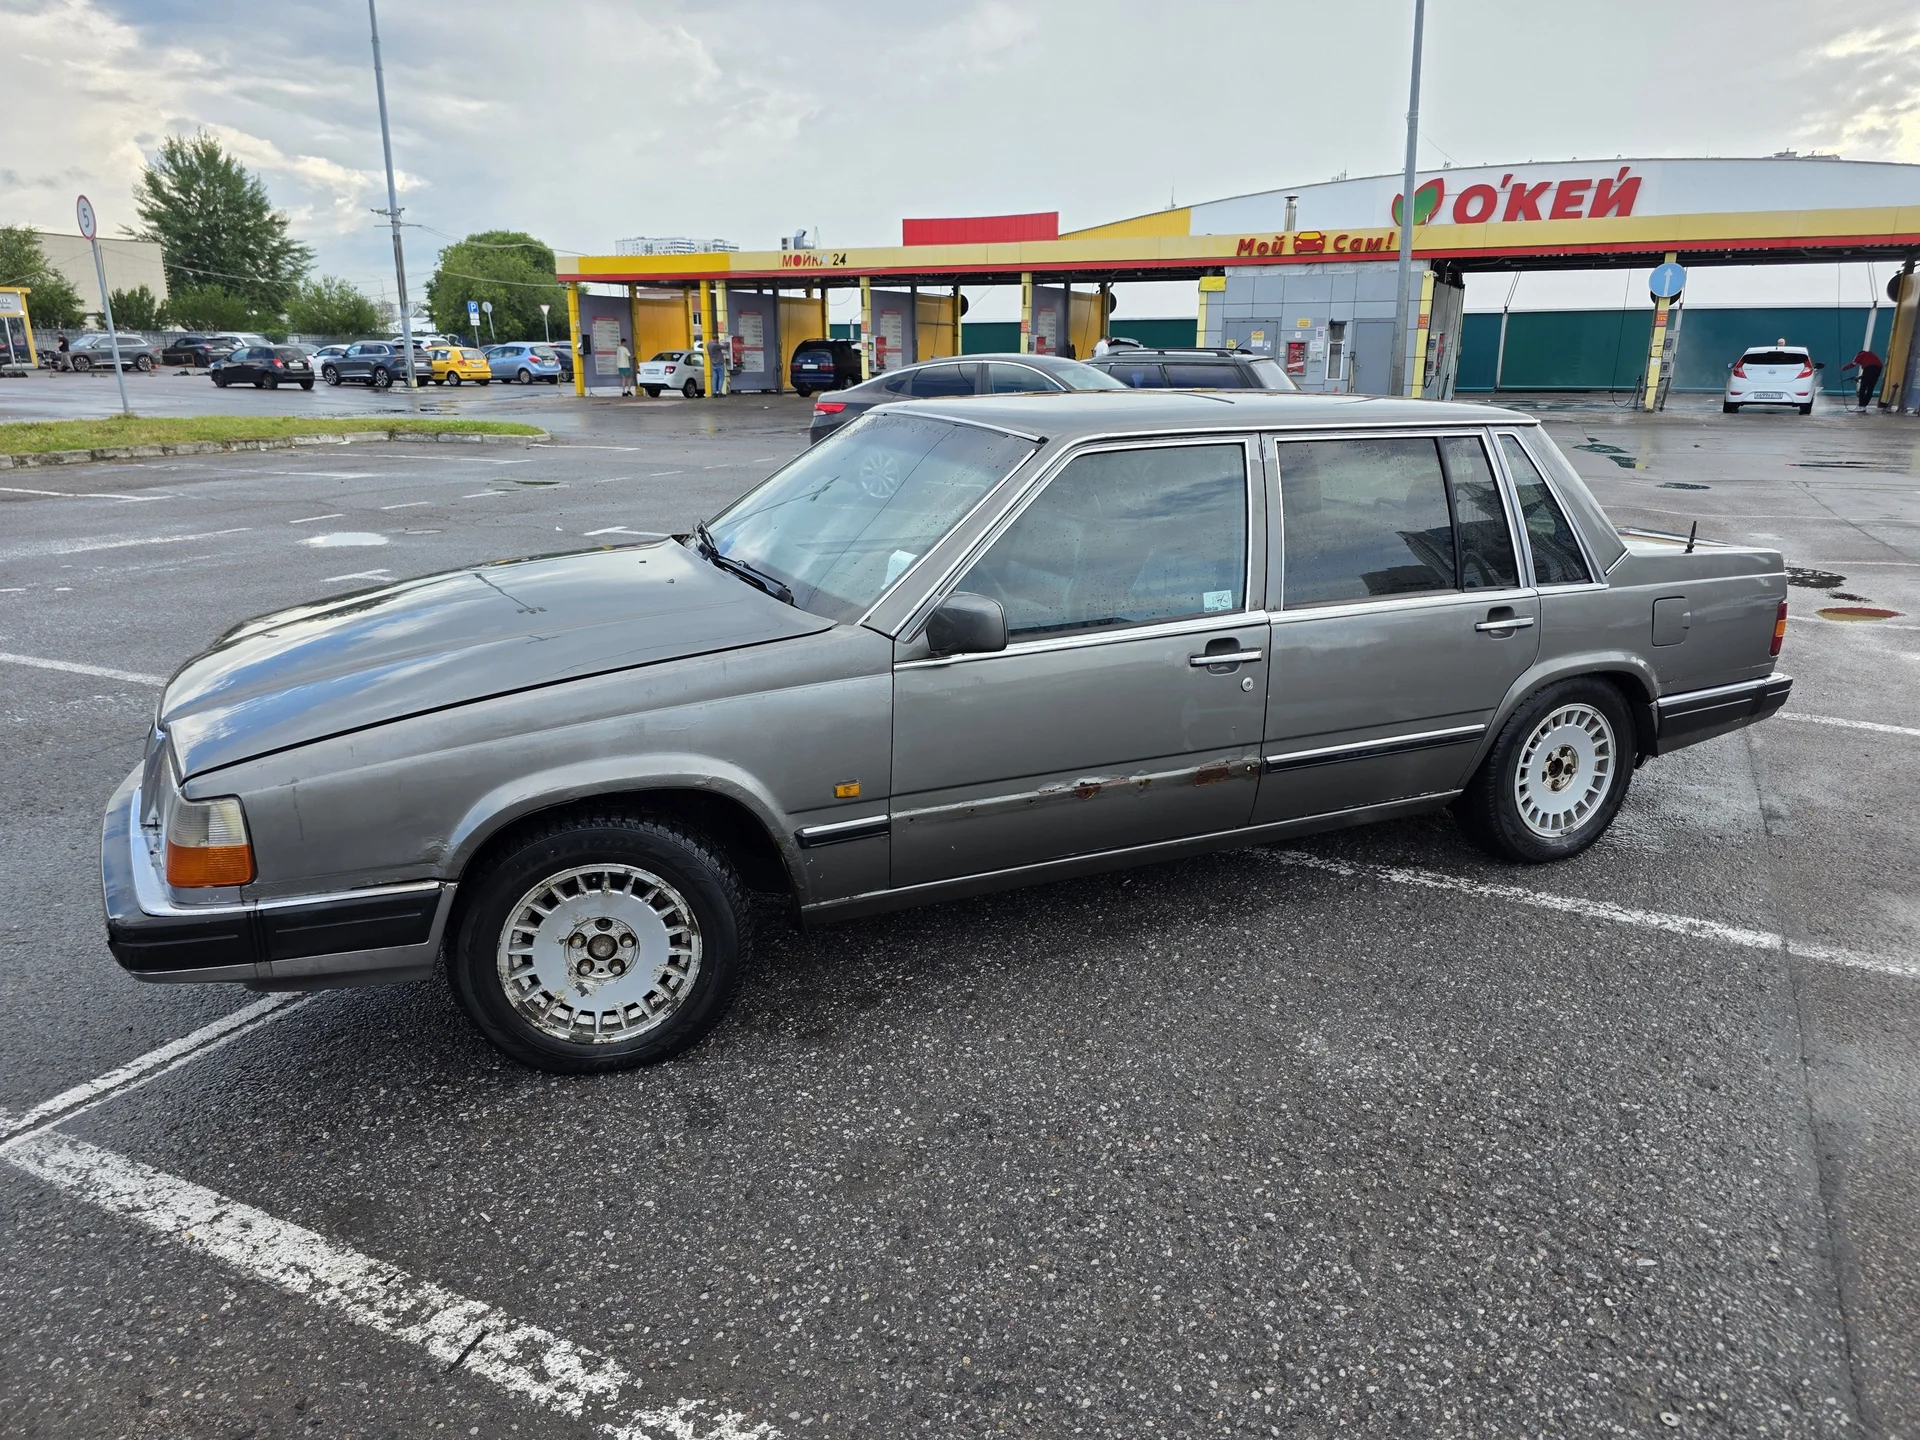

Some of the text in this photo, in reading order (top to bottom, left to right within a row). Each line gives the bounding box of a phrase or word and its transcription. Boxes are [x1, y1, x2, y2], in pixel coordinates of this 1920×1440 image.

[82, 207, 90, 228] 5
[1236, 231, 1395, 256] Мой Сам!
[782, 250, 847, 267] МОЙКА 24
